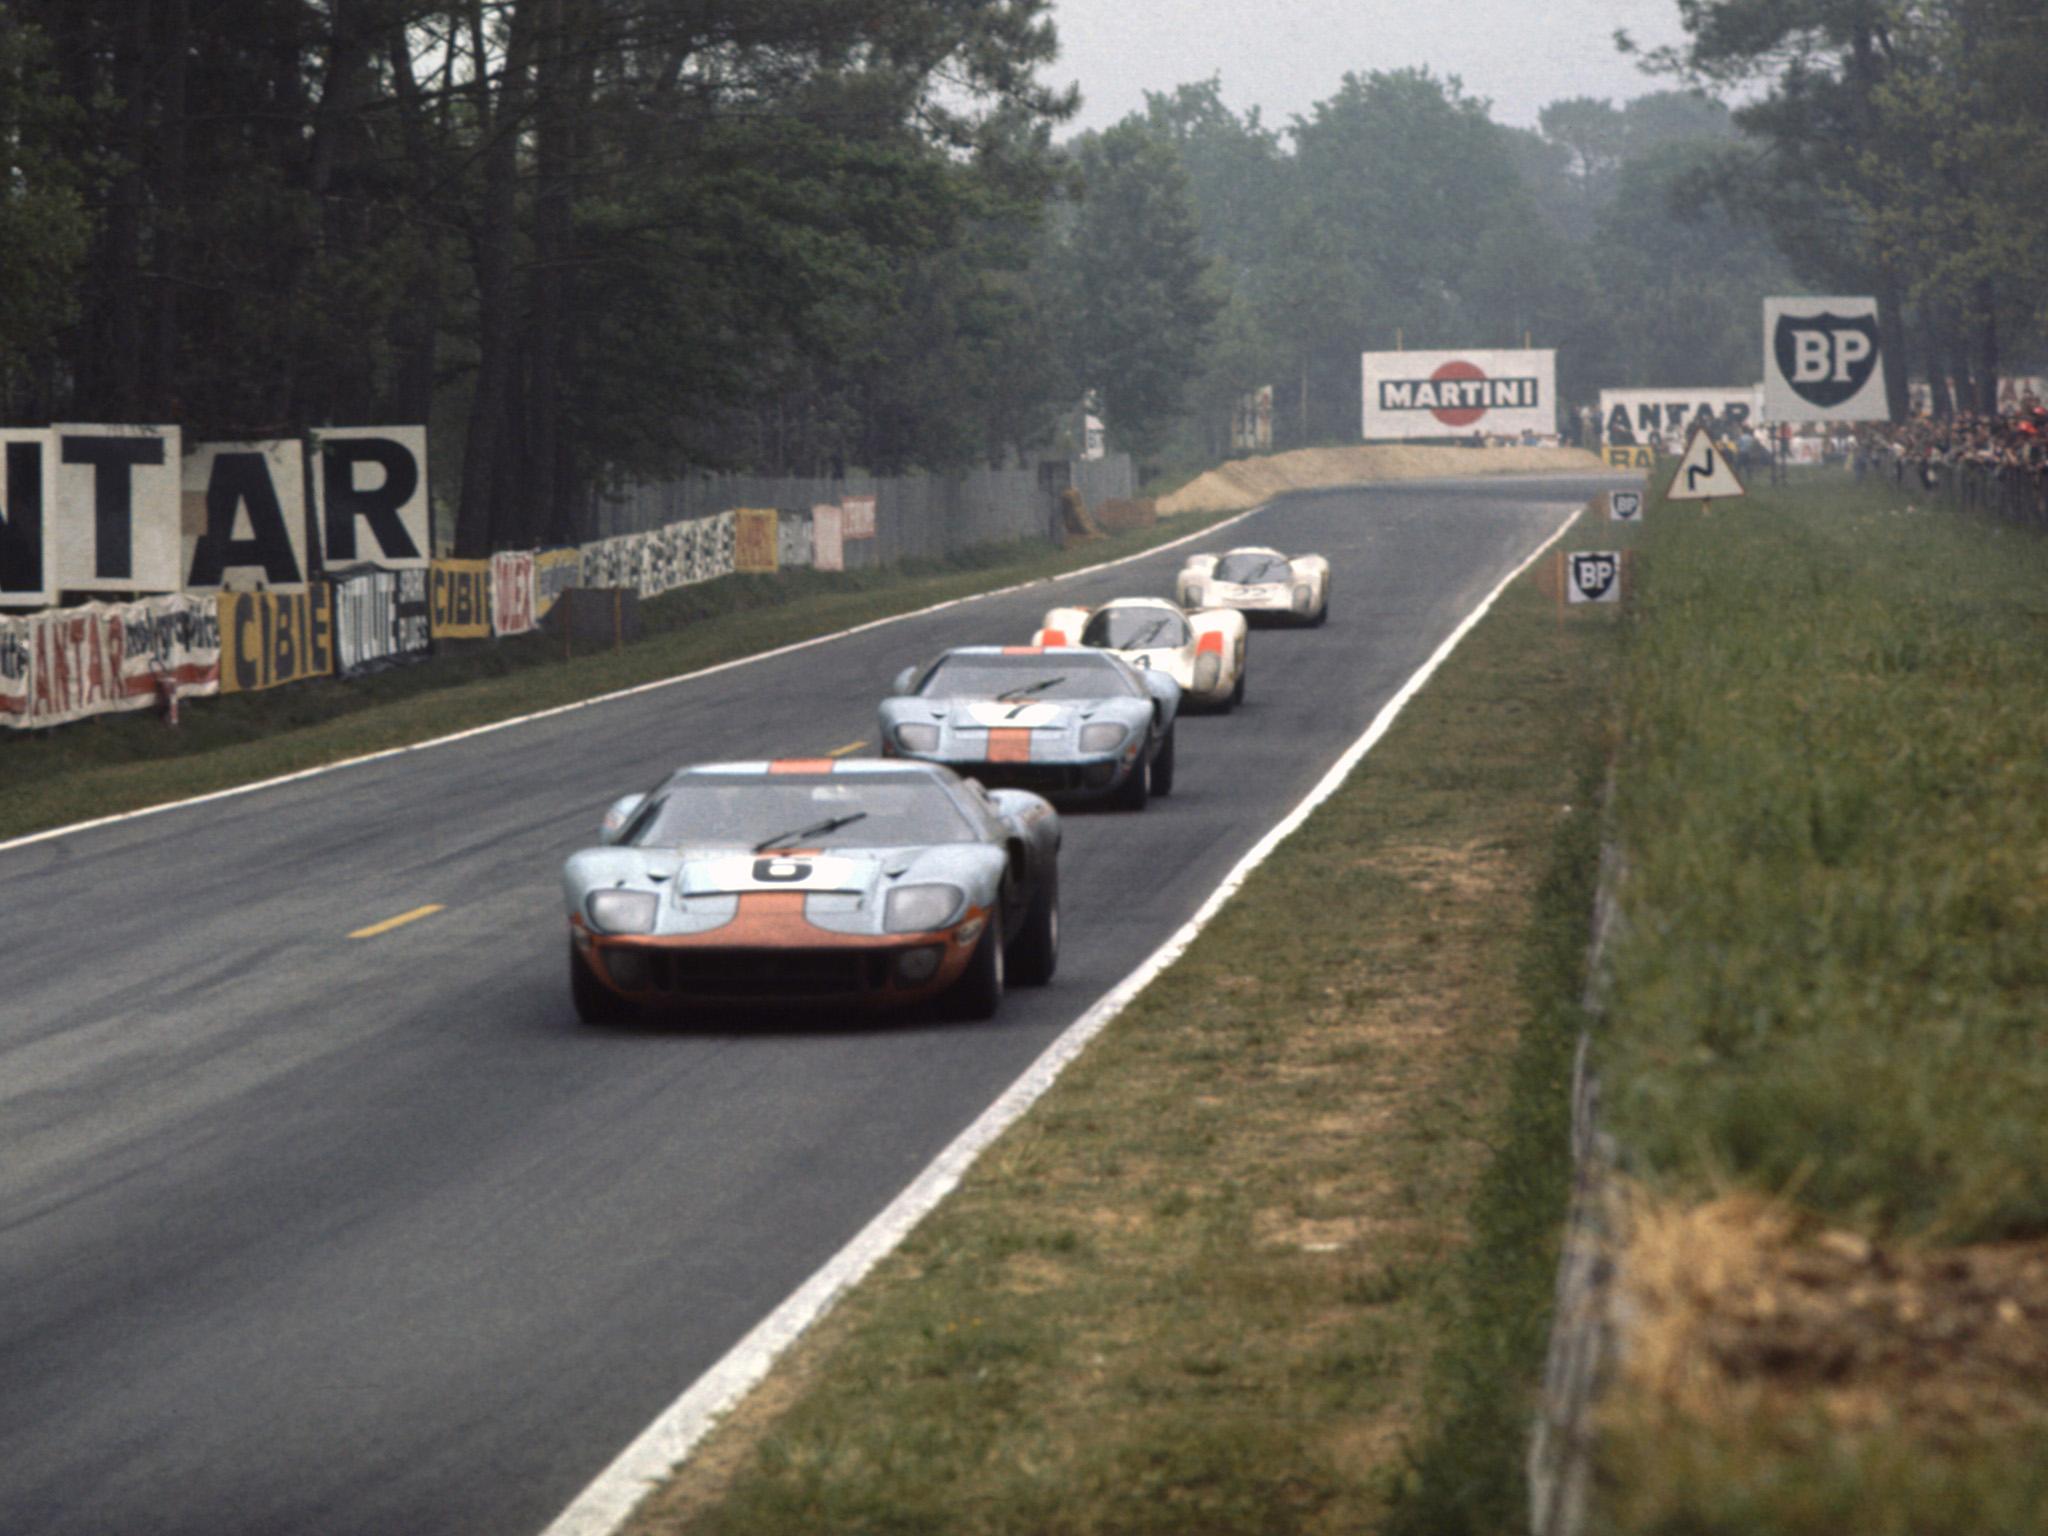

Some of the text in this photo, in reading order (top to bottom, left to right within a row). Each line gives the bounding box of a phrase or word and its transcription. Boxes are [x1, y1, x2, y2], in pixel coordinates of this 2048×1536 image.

[1792, 330, 1871, 382] BP
[1384, 380, 1533, 408] MARTINI
[1608, 403, 1750, 431] ANTAR
[1617, 496, 1637, 512] BP
[1579, 561, 1612, 590] BP
[33, 613, 127, 716] ANTAR
[752, 857, 813, 883] 6
